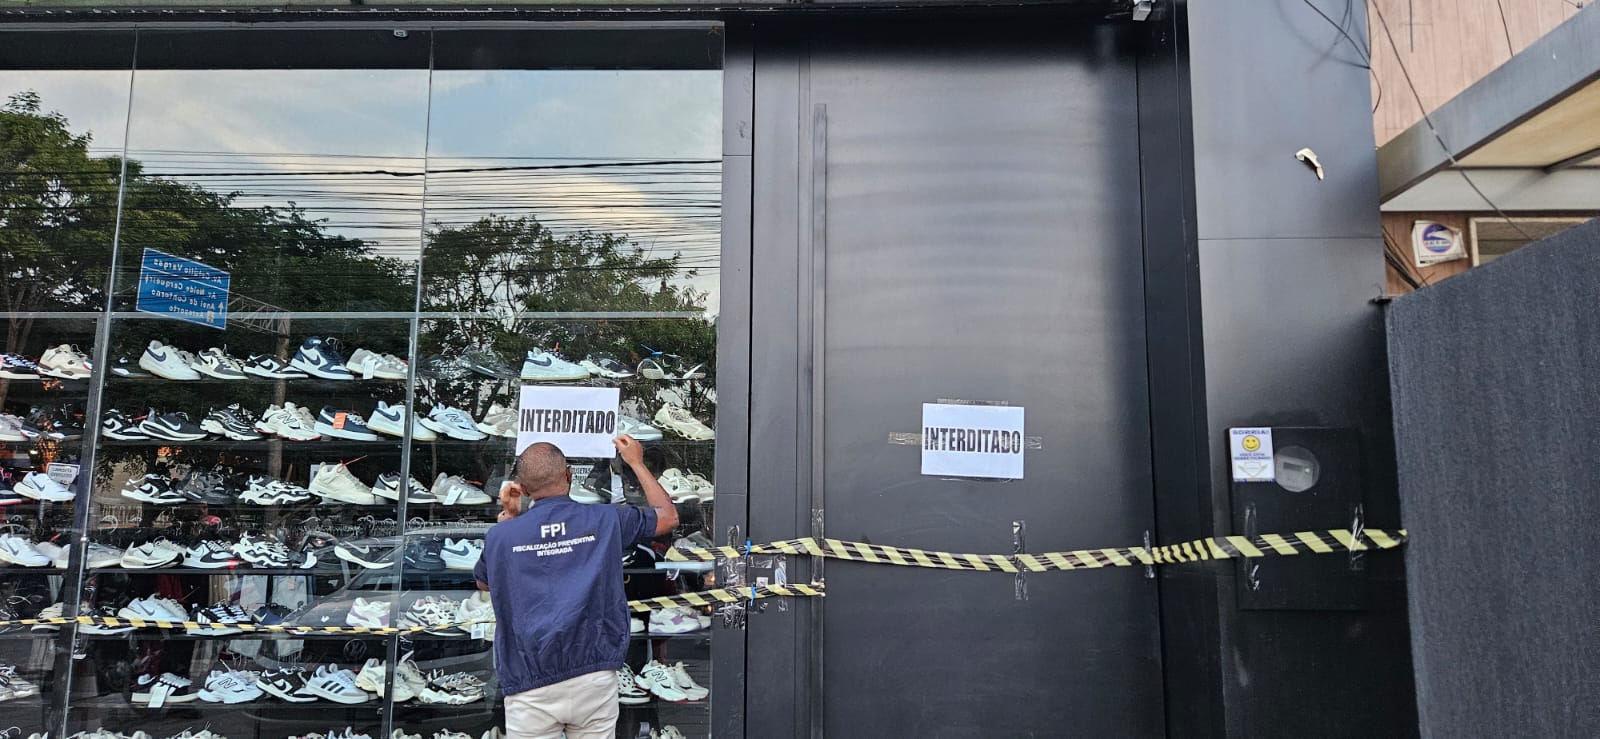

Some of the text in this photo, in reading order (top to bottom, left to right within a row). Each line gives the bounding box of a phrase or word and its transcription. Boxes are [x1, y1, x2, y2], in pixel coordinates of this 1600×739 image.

[520, 408, 616, 434] INTERDITADO
[924, 427, 1021, 454] INTERDITADO
[540, 522, 566, 538] FPI
[512, 535, 596, 553] FISCALIZAÇÃO PREVENTIVA
[536, 546, 573, 557] INTEGRADA
